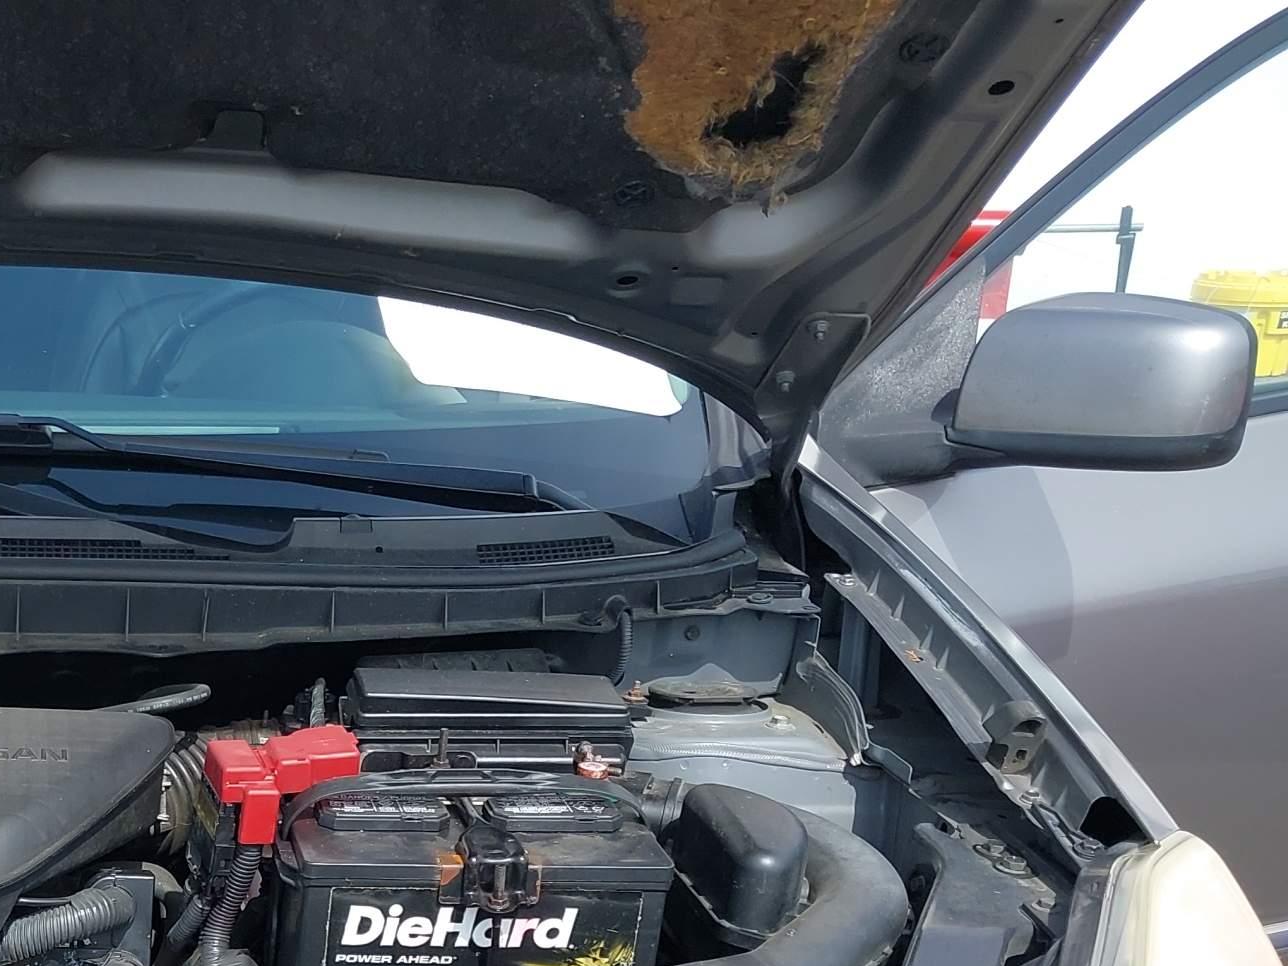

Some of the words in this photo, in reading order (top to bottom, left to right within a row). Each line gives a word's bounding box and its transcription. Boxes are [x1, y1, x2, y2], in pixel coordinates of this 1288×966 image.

[341, 903, 579, 949] DieHard
[335, 954, 392, 964] POWER
[396, 955, 453, 965] AHEAD
